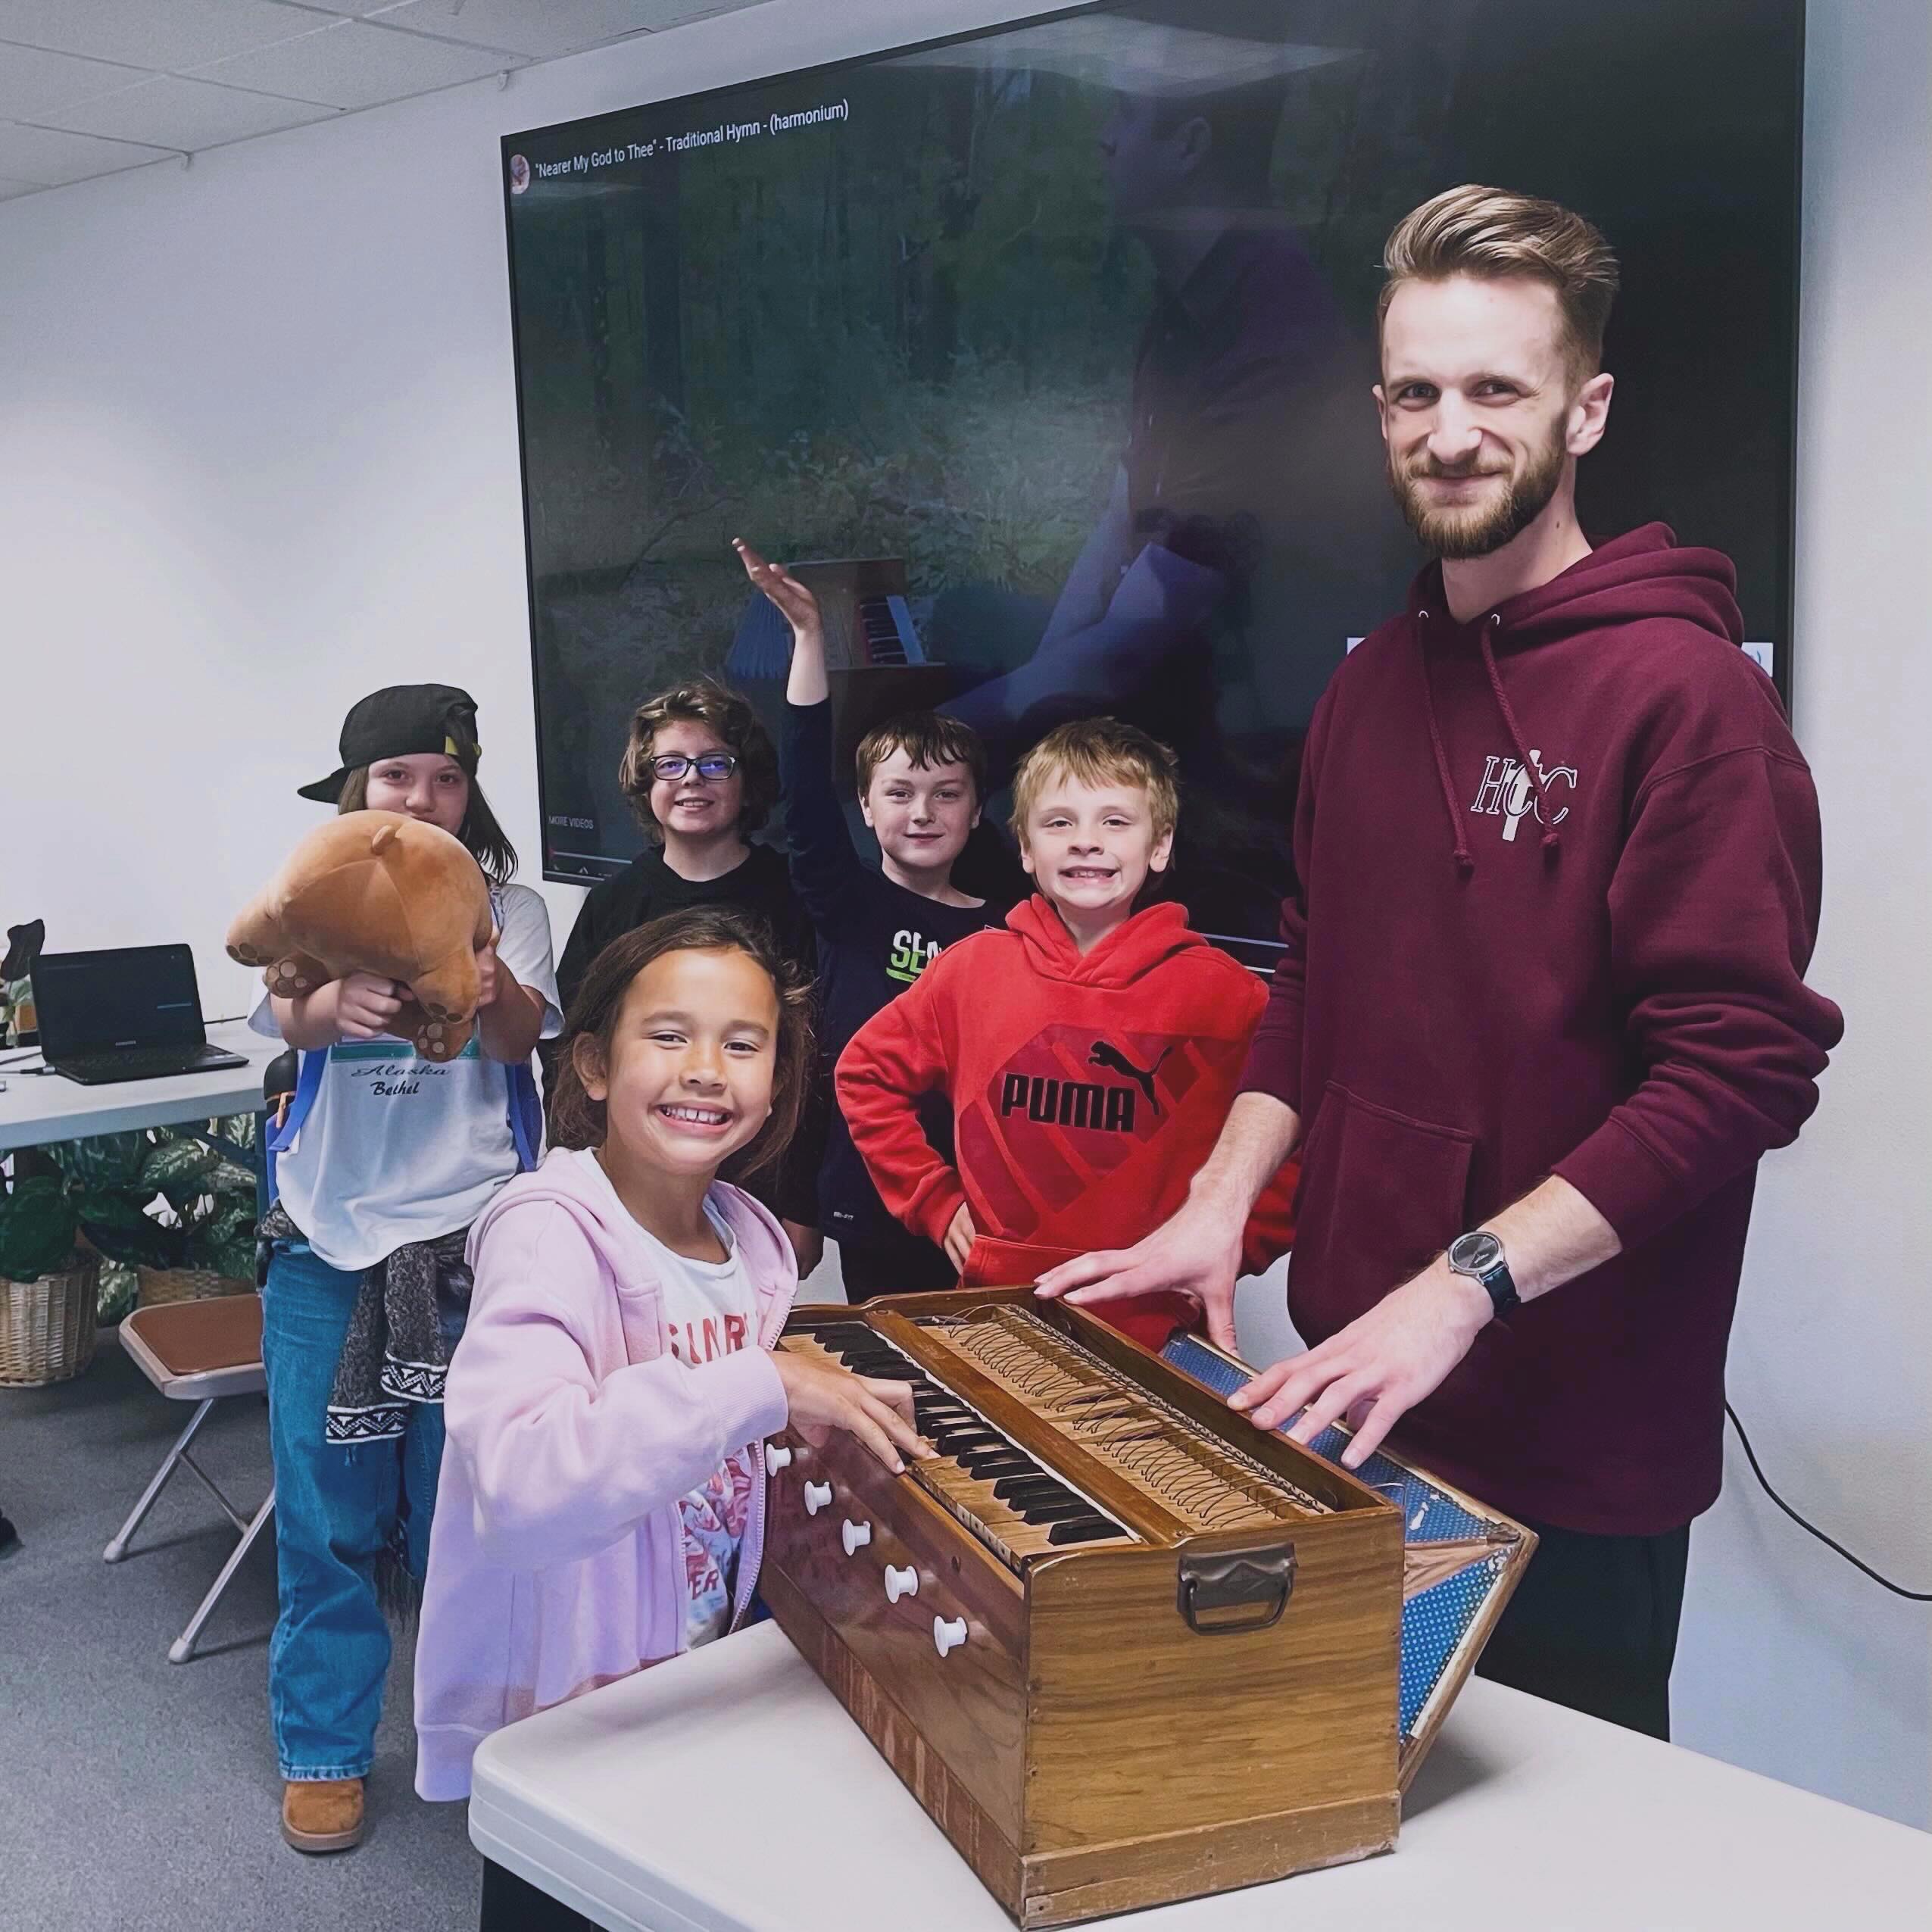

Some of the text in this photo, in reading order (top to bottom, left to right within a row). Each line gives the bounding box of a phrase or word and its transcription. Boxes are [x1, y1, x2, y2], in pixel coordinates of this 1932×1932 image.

[573, 155, 589, 173] My
[591, 148, 612, 167] God
[614, 148, 626, 163] to
[665, 126, 724, 152] Traditional
[726, 121, 760, 142] Hymn
[769, 98, 849, 136] (harmonium)
[569, 817, 595, 829] VIDEOS
[891, 929, 942, 974] SEA
[351, 1064, 448, 1077] Alaska
[1000, 1072, 1135, 1134] PUMA
